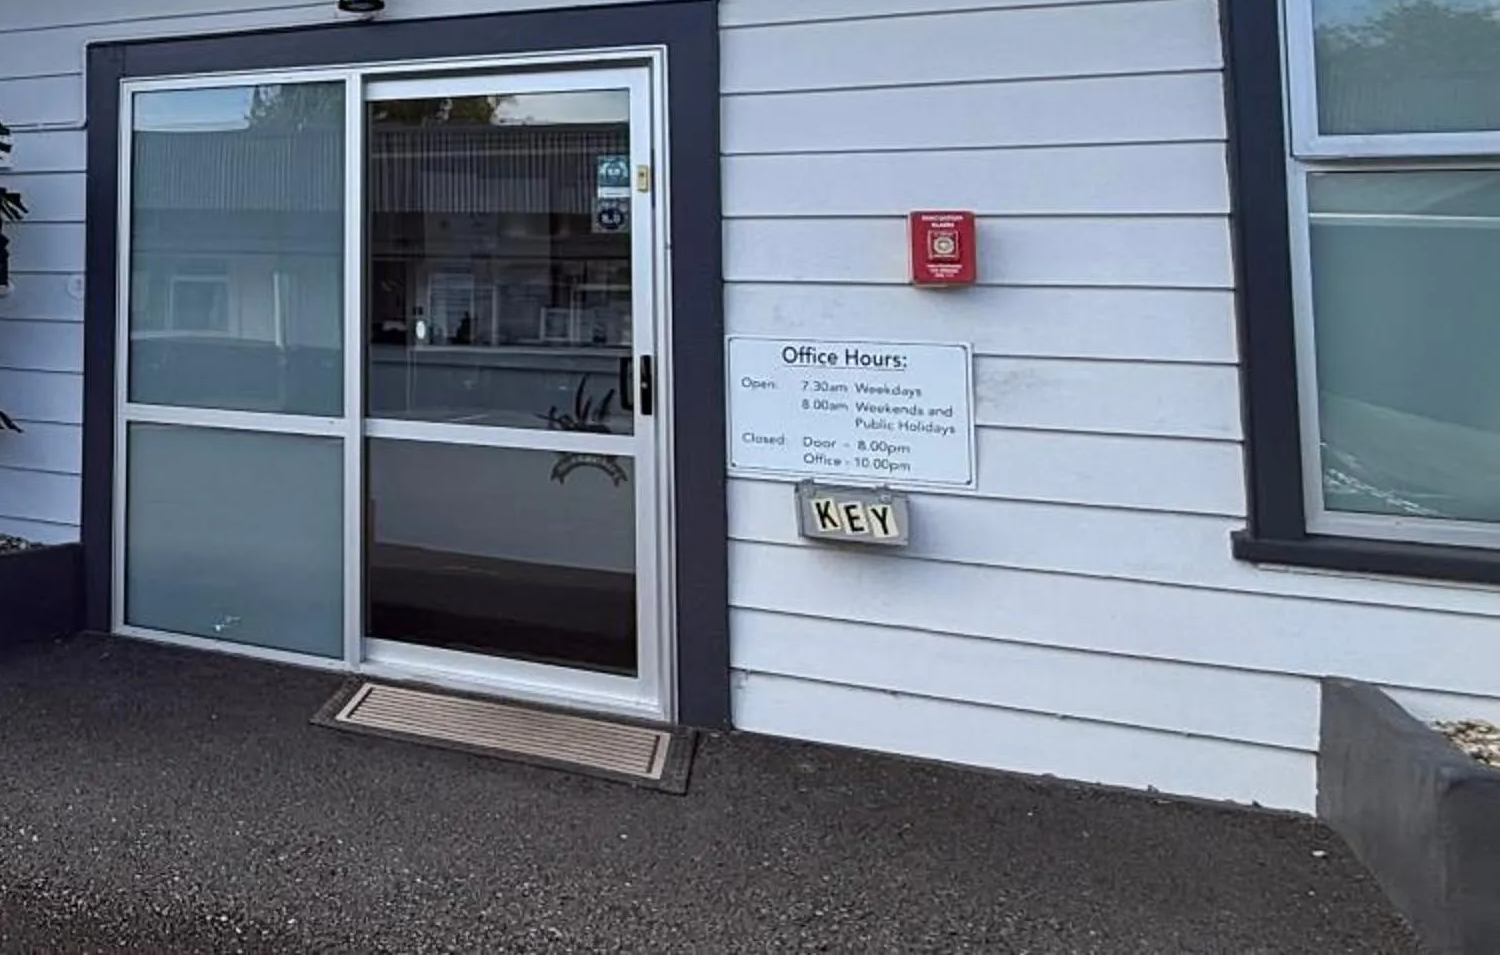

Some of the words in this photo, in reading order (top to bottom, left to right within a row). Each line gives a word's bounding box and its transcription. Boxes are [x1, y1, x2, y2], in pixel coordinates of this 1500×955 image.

[782, 346, 838, 365] Office
[845, 348, 907, 368] Hours:
[855, 383, 921, 398] Weekdays
[855, 402, 924, 416] Weekends
[928, 405, 953, 417] and
[855, 417, 893, 430] Public
[898, 420, 956, 437] Holidays
[803, 436, 836, 448] Door
[803, 453, 842, 466] Office
[815, 501, 889, 535] KEY
